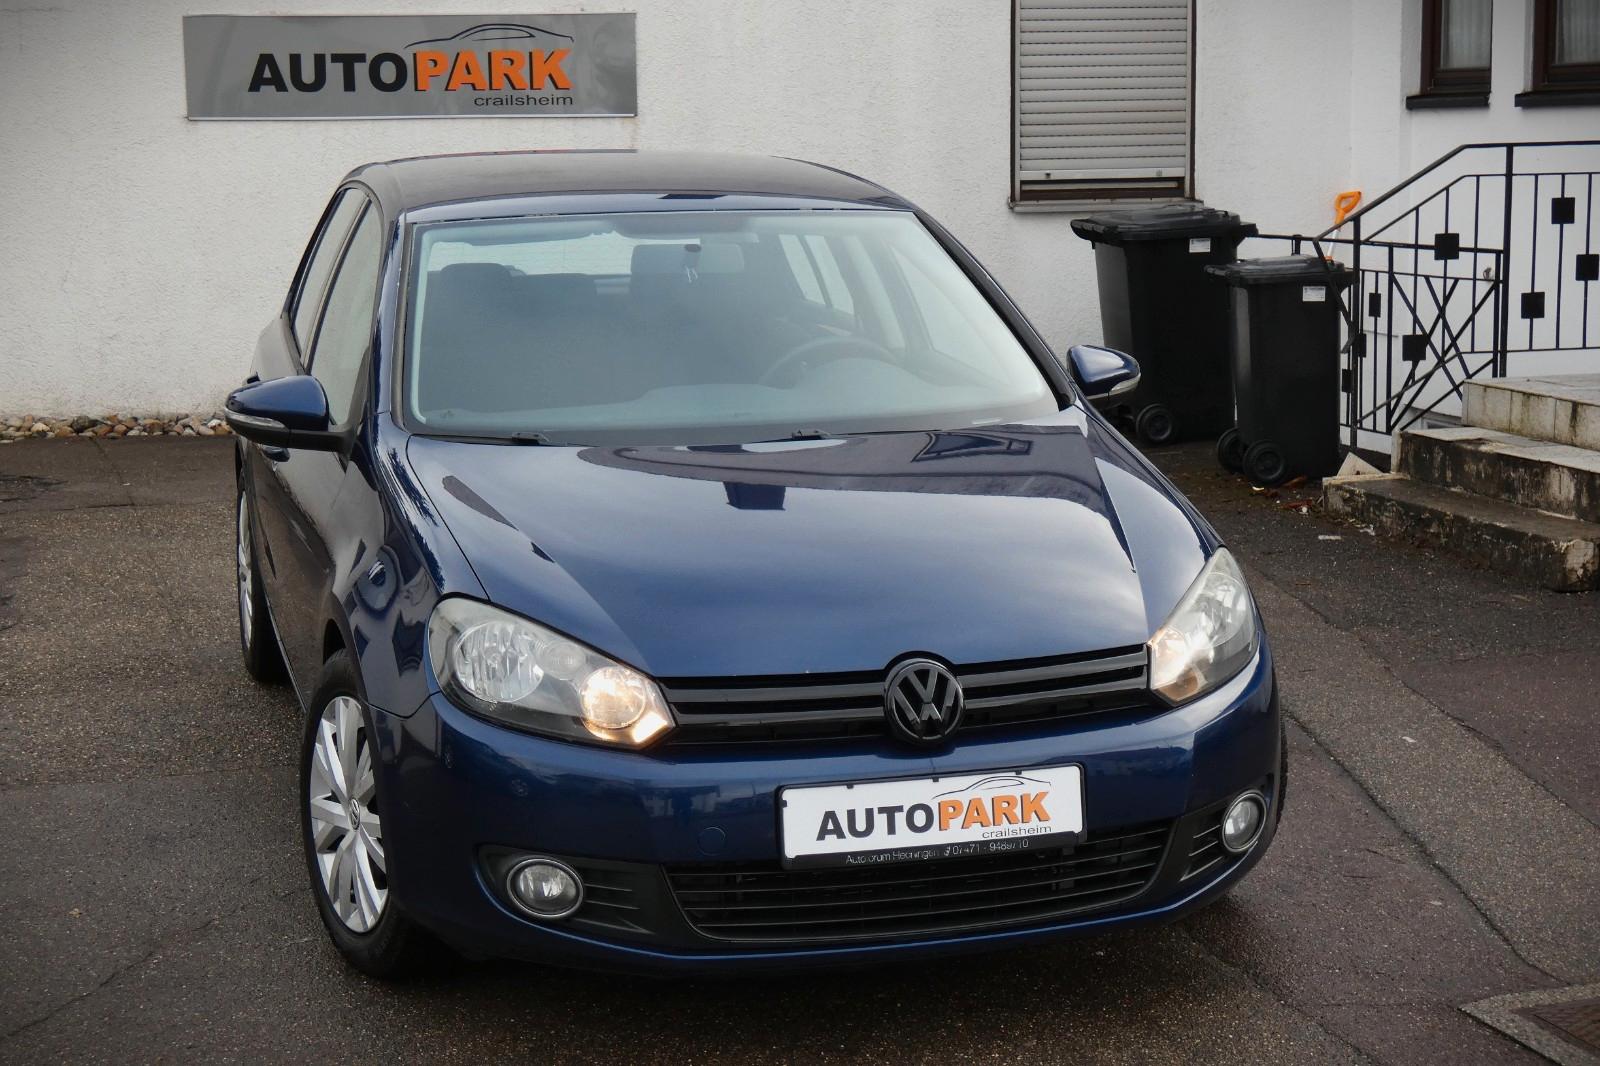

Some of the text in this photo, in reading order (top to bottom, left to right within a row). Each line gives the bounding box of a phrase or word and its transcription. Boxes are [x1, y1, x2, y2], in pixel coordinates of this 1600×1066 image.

[248, 48, 574, 93] AUTOPARK
[474, 93, 573, 107] crailsheim
[889, 663, 960, 740] VW
[815, 791, 1050, 841] AUTOPARK
[982, 824, 1052, 839] crailsheim
